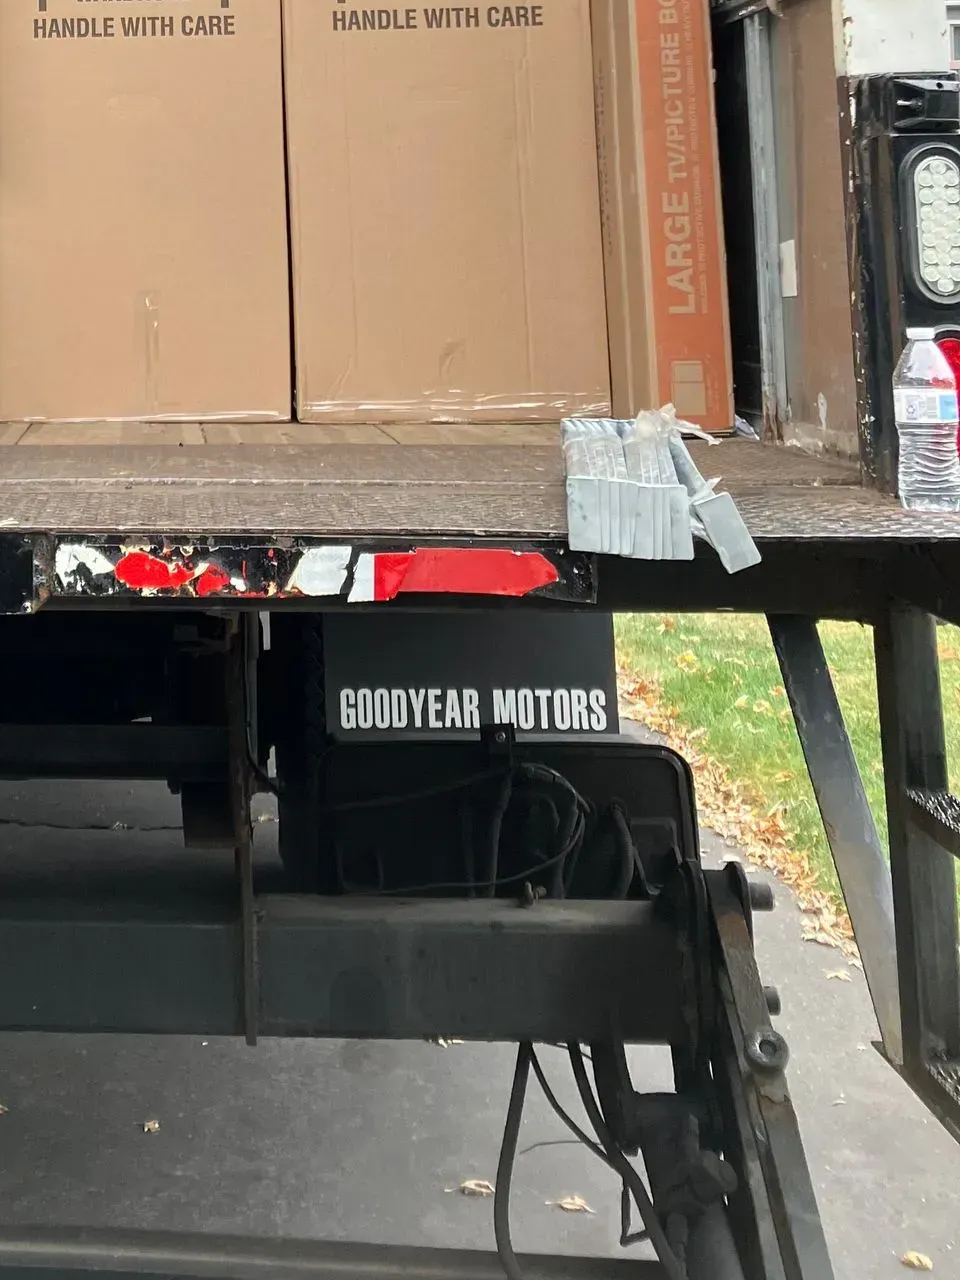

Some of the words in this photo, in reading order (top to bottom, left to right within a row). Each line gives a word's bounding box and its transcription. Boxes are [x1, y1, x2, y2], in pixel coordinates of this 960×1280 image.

[33, 17, 115, 39] HANDLE
[121, 16, 174, 37] WITH
[181, 15, 235, 36] CARE
[332, 9, 418, 31] HANDLE
[424, 7, 479, 29] WITH
[487, 6, 544, 27] CARE
[660, 32, 687, 183] TV/PICTURE
[661, 191, 696, 314] LARGE
[339, 688, 480, 730] GOODYEAR
[492, 688, 607, 732] MOTORS
